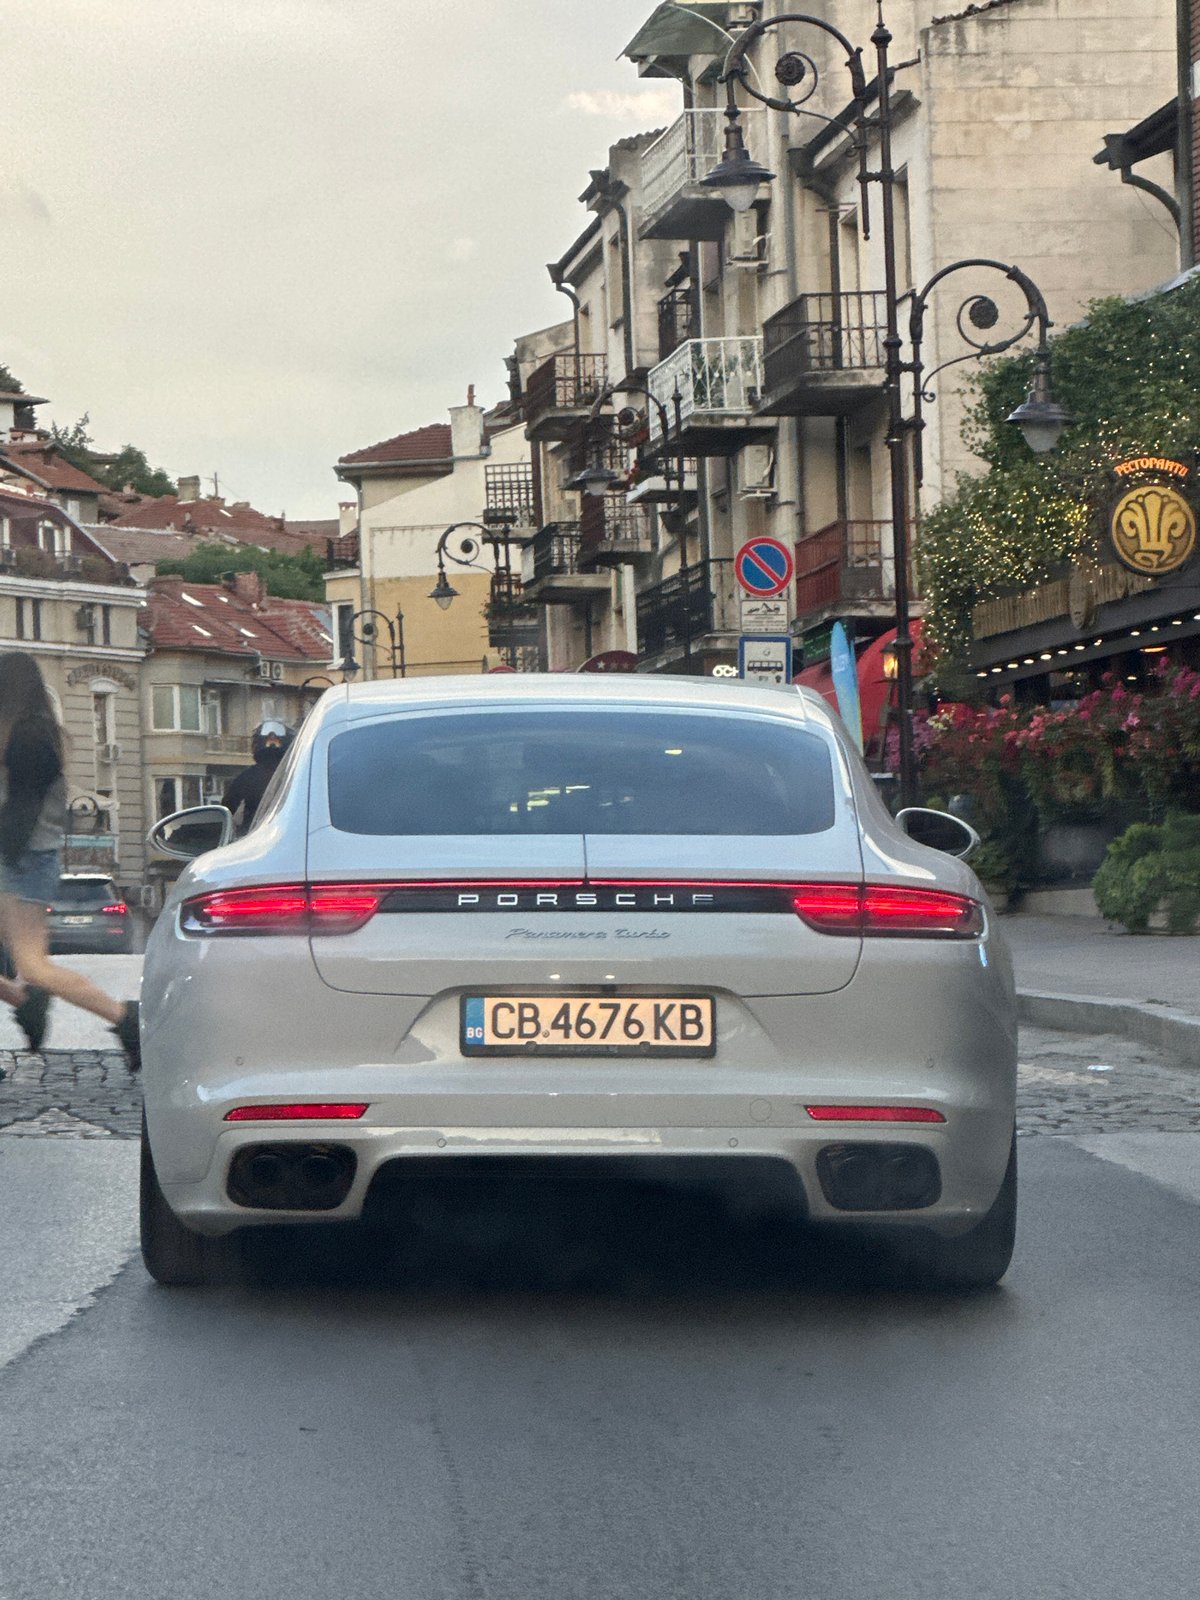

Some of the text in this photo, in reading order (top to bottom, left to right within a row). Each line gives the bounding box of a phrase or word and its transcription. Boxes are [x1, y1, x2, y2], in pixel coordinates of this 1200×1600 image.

[457, 893, 715, 906] PORSCHE
[504, 928, 673, 940] Panamera Turbo
[466, 1026, 484, 1039] BG
